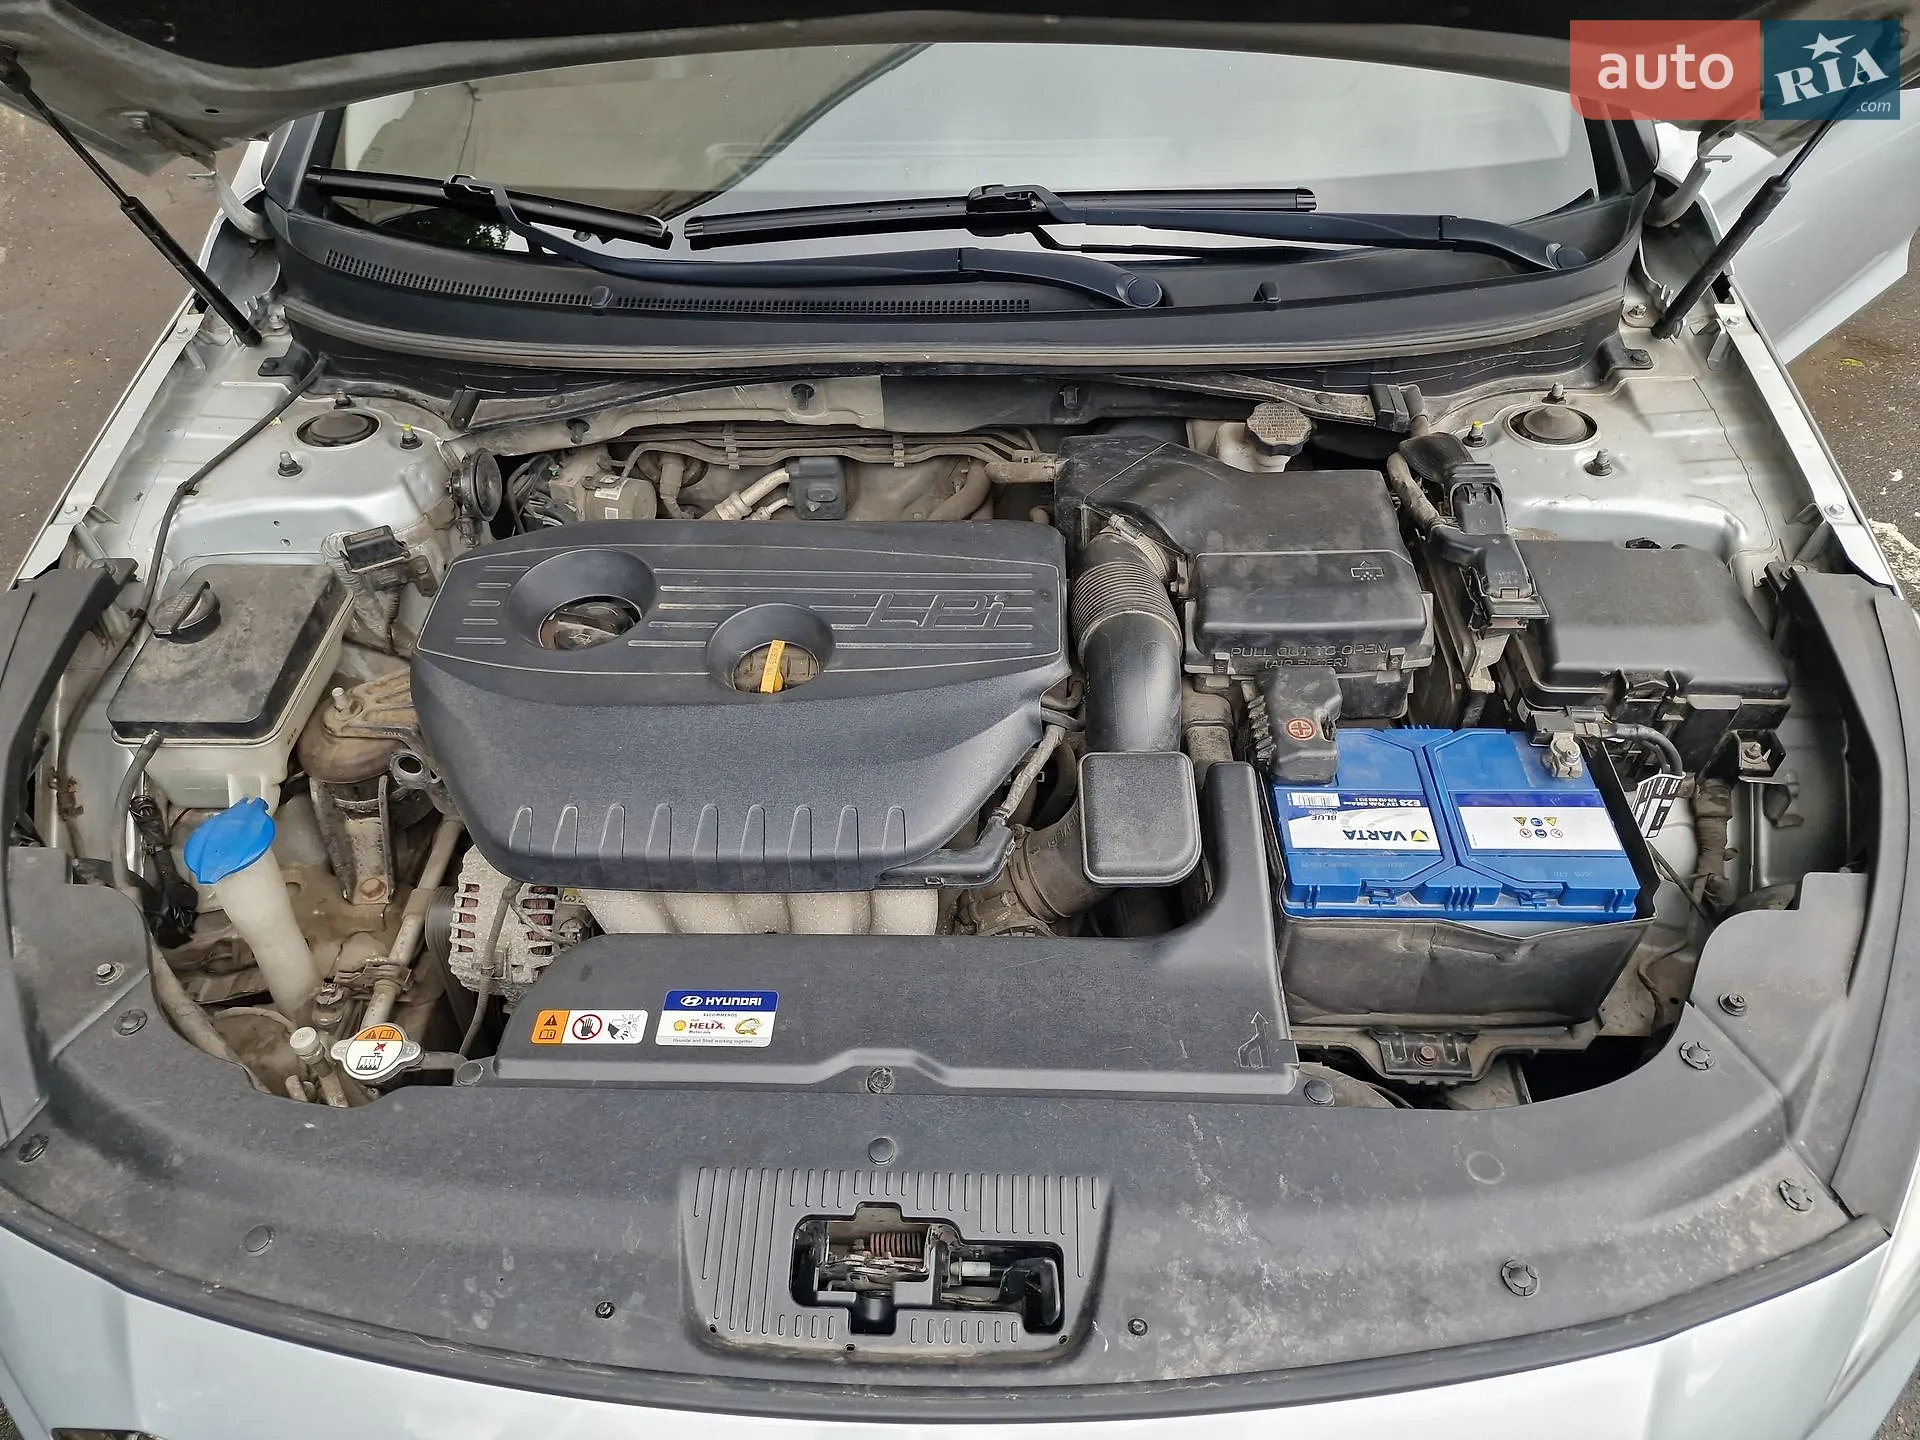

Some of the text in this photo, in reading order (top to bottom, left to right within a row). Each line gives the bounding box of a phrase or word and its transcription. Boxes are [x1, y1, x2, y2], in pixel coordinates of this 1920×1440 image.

[1230, 643, 1388, 658] PULL OUT TO OPEN
[1399, 799, 1421, 807] E23
[1342, 830, 1408, 841] VARTA
[705, 996, 762, 1006] HYUNDAI
[689, 1021, 724, 1030] HELIX
